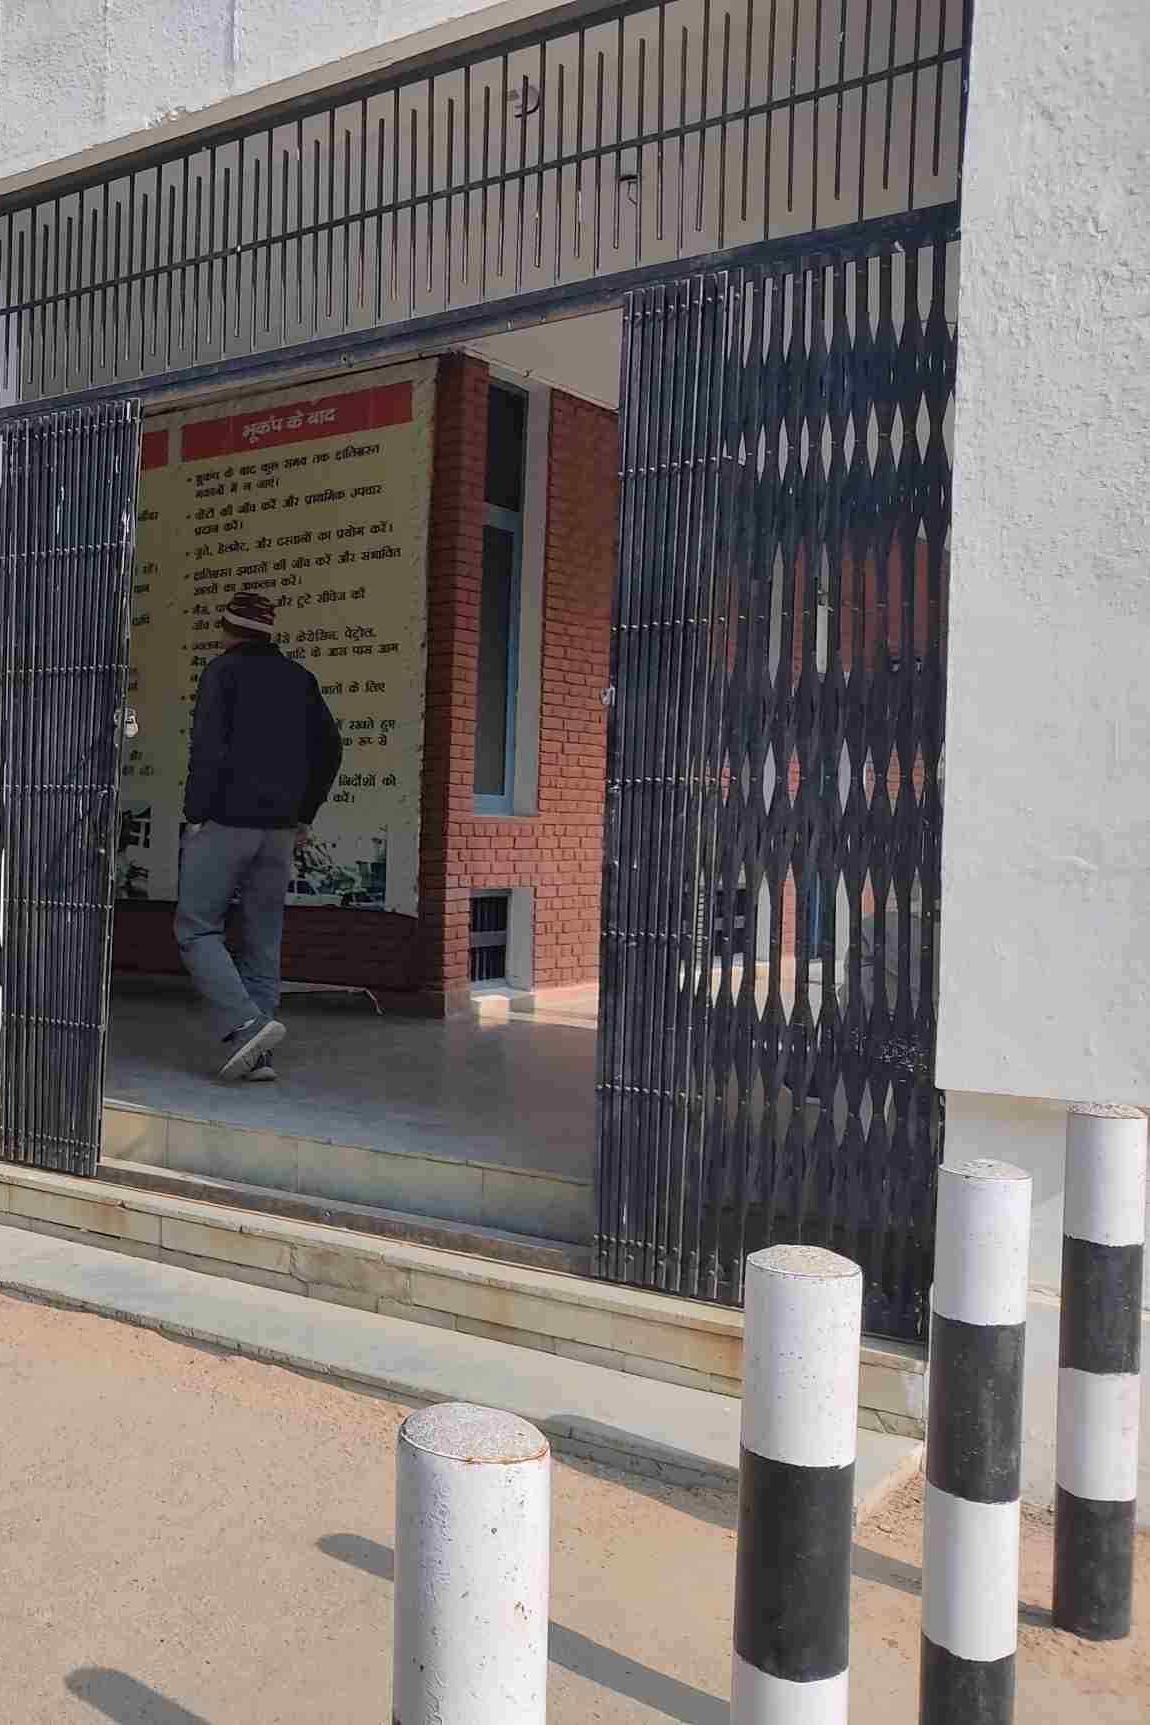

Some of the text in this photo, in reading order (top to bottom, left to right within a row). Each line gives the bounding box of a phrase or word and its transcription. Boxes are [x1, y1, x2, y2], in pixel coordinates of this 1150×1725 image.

[242, 407, 338, 447] भूकंप के बाद
[224, 465, 235, 478] के
[239, 464, 256, 477] बाद
[311, 453, 329, 465] तक
[281, 495, 299, 509] और
[256, 536, 272, 549] और
[317, 531, 331, 542] का
[337, 550, 355, 564] और
